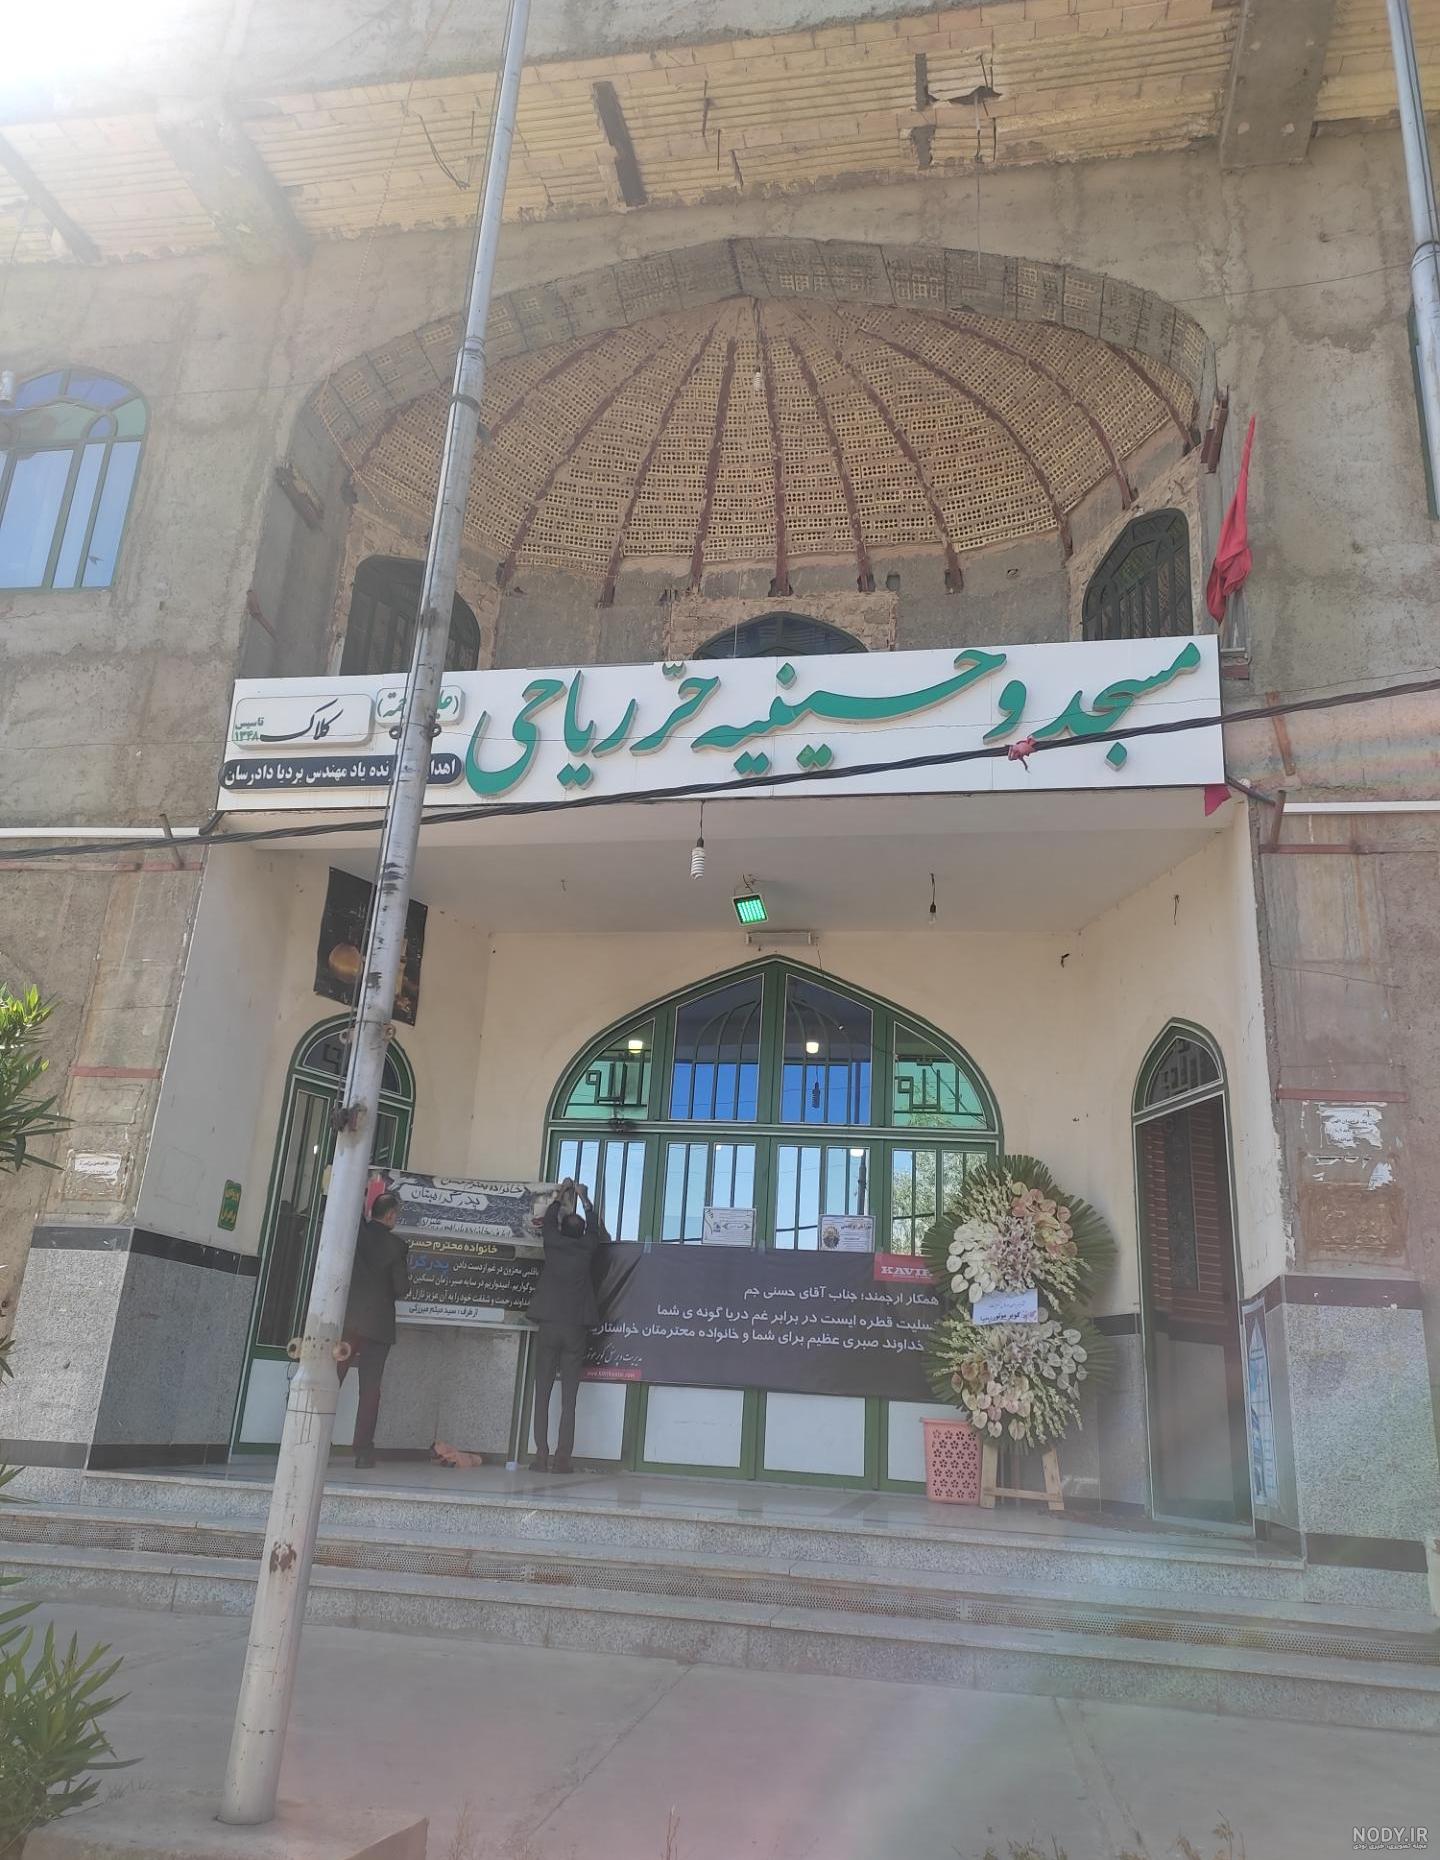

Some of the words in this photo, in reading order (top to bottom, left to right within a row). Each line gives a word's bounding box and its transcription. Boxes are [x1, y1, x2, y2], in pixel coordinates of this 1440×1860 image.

[691, 649, 1007, 776] حسینیه
[983, 680, 1027, 744] و
[1030, 642, 1200, 771] مسجد
[259, 697, 344, 743] کلاک
[466, 669, 639, 797] ریاحی
[224, 764, 274, 786] دادرسان
[275, 764, 304, 784] بردیا
[305, 763, 347, 783] مهندس
[349, 761, 366, 781] یاد
[432, 1240, 464, 1252] محترم
[464, 1241, 498, 1256] خانواده
[743, 1286, 760, 1301] جم
[763, 1286, 796, 1300] حسنی
[799, 1285, 826, 1300] آقای
[828, 1288, 858, 1302] جناب
[905, 1292, 939, 1306] همکار
[656, 1304, 680, 1316] شما
[695, 1306, 723, 1321] گونه
[725, 1306, 749, 1321] دریا
[770, 1311, 799, 1324] برابر
[751, 1310, 769, 1326] غم
[801, 1314, 818, 1325] در
[820, 1314, 857, 1326] ایست
[859, 1316, 893, 1331] قطره
[641, 1323, 696, 1339] محترمتان
[698, 1327, 739, 1344] خانواده
[742, 1333, 750, 1342] و
[751, 1328, 775, 1342] شما
[778, 1331, 804, 1345] برای
[806, 1333, 840, 1348] عظیم
[842, 1338, 879, 1350] صبری
[882, 1337, 924, 1353] خداوند
